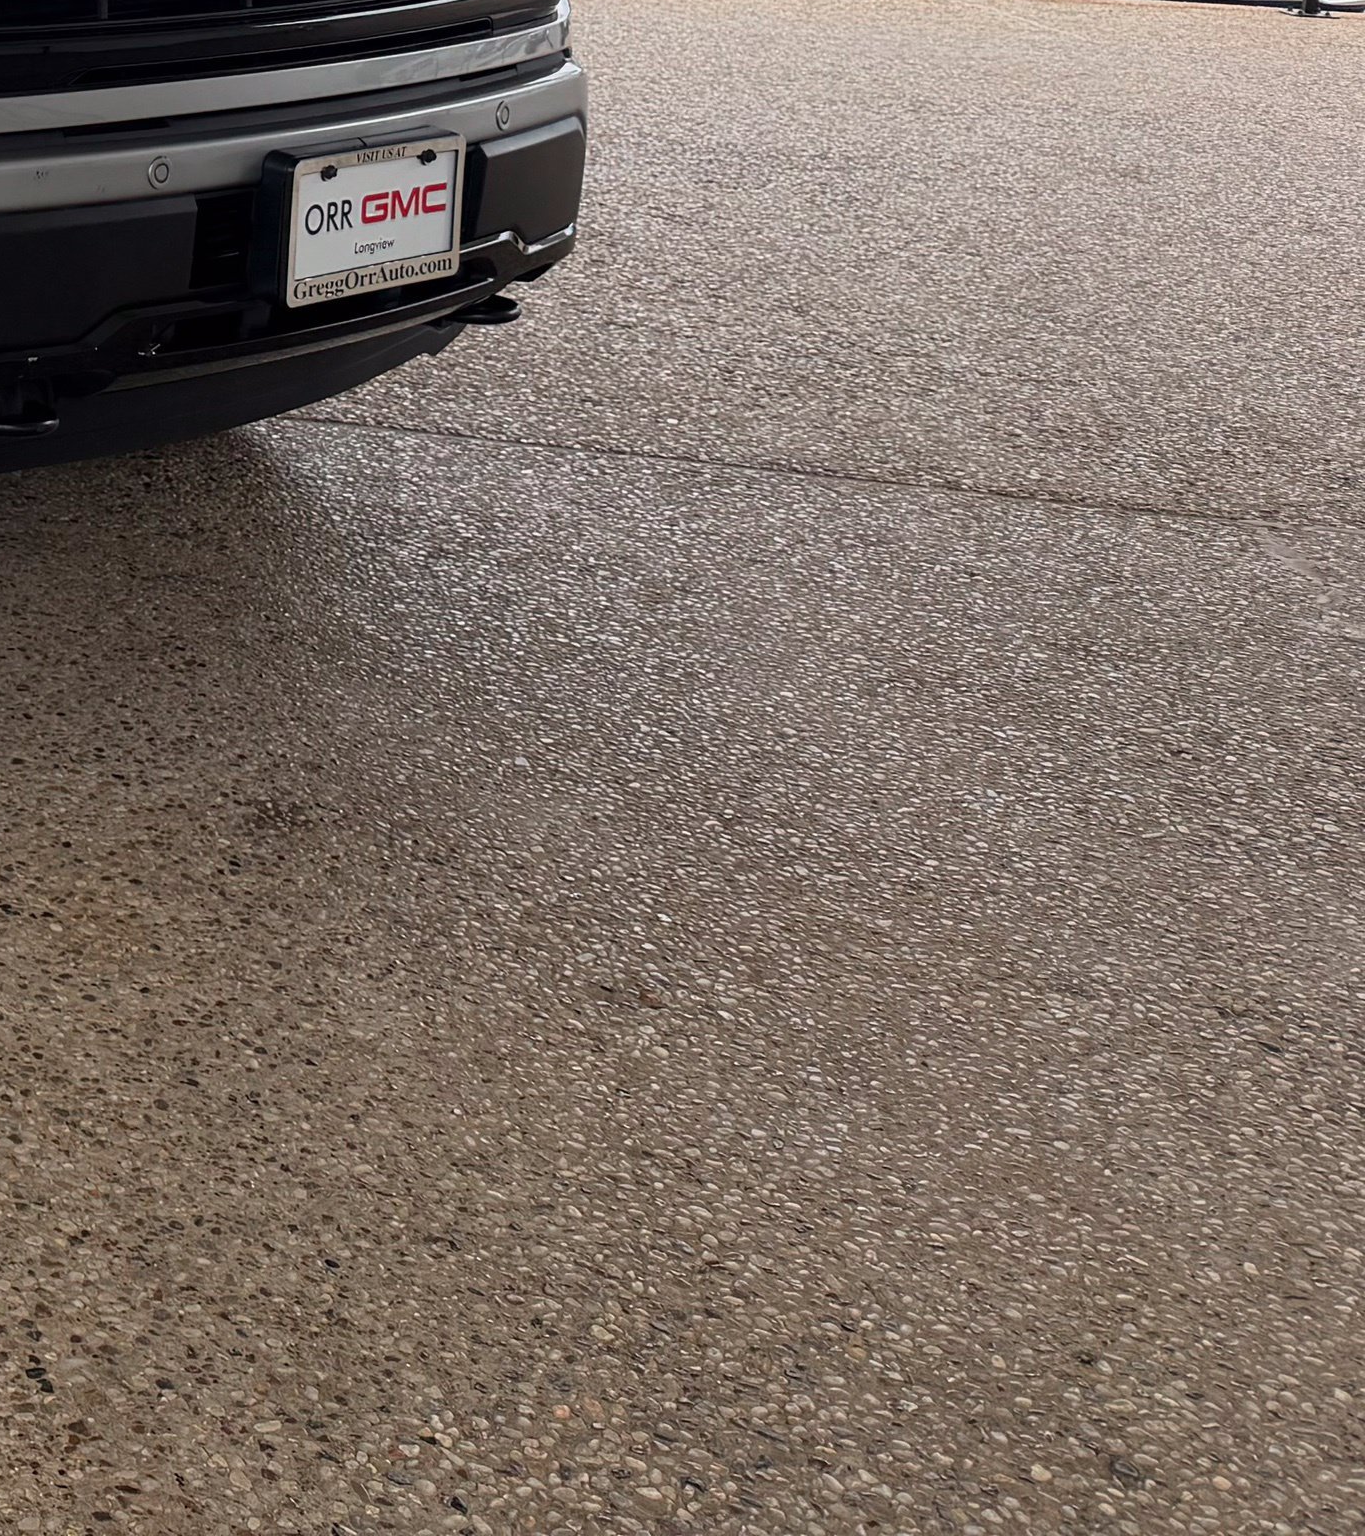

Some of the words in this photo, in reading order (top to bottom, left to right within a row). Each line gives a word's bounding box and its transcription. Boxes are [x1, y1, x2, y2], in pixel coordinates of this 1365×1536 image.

[356, 149, 381, 164] VISIT
[382, 148, 394, 159] US
[394, 146, 407, 158] AT
[305, 199, 353, 235] ORR
[361, 182, 447, 224] GMC
[354, 238, 395, 254] Longview
[293, 257, 452, 300] GreggOrrAuto.com
